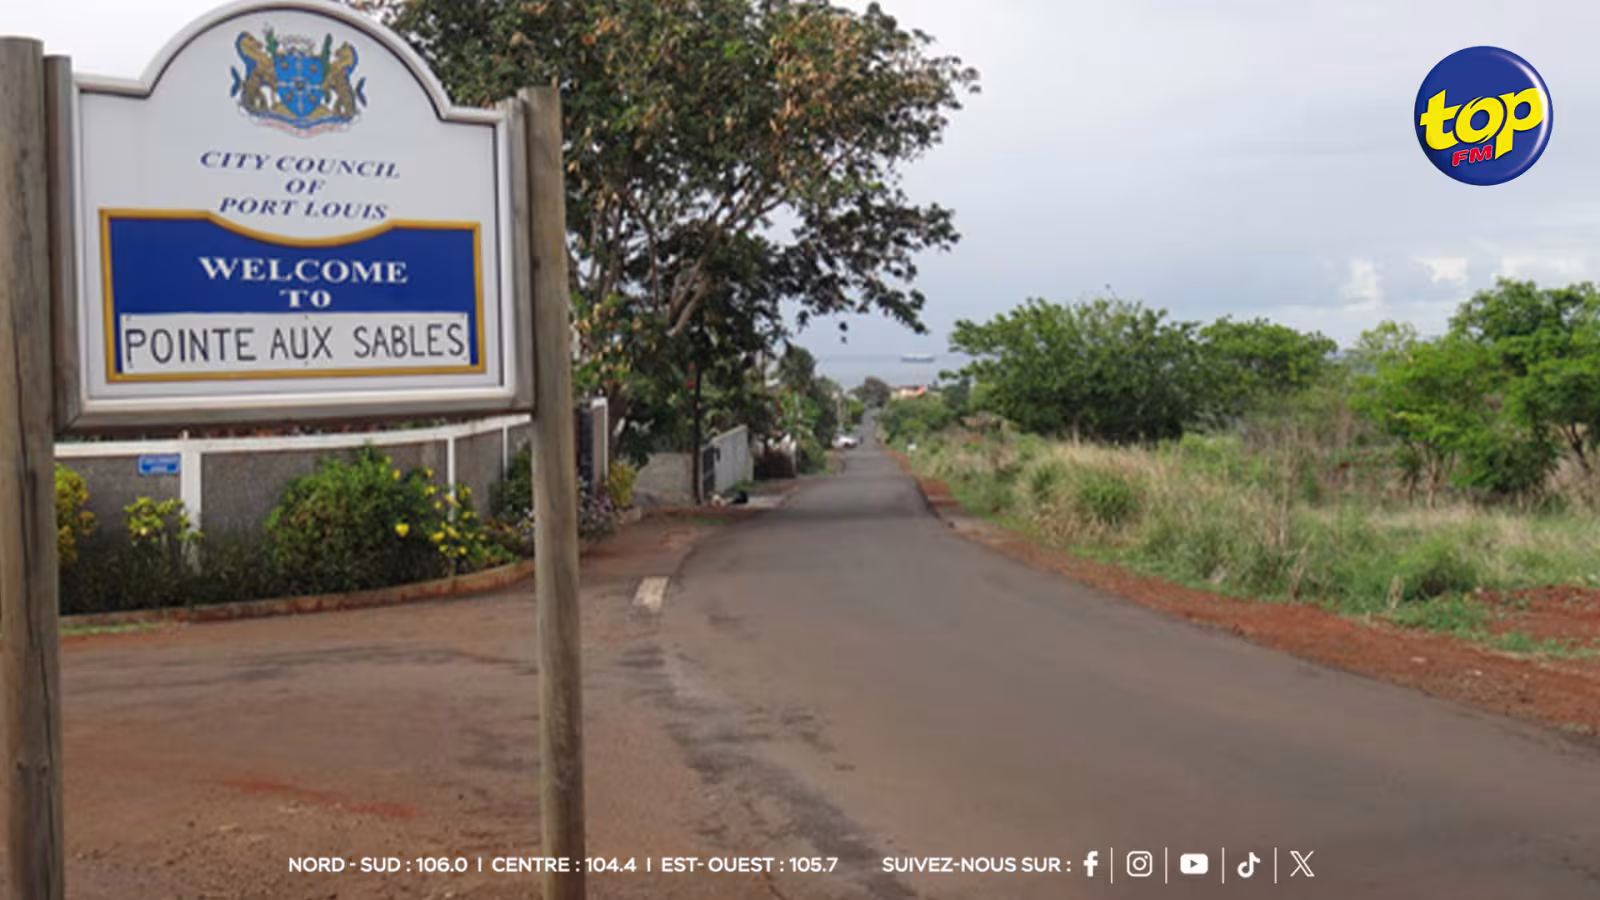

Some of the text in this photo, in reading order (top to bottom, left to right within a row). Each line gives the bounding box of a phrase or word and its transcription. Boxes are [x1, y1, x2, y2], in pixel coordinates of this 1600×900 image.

[200, 151, 400, 178] CITY COUNCIL
[285, 179, 325, 196] OF
[219, 197, 388, 220] PORT LOUIS
[199, 257, 408, 283] WELCOME
[279, 290, 331, 308] TO
[125, 322, 466, 364] POINTE AUX SABLES
